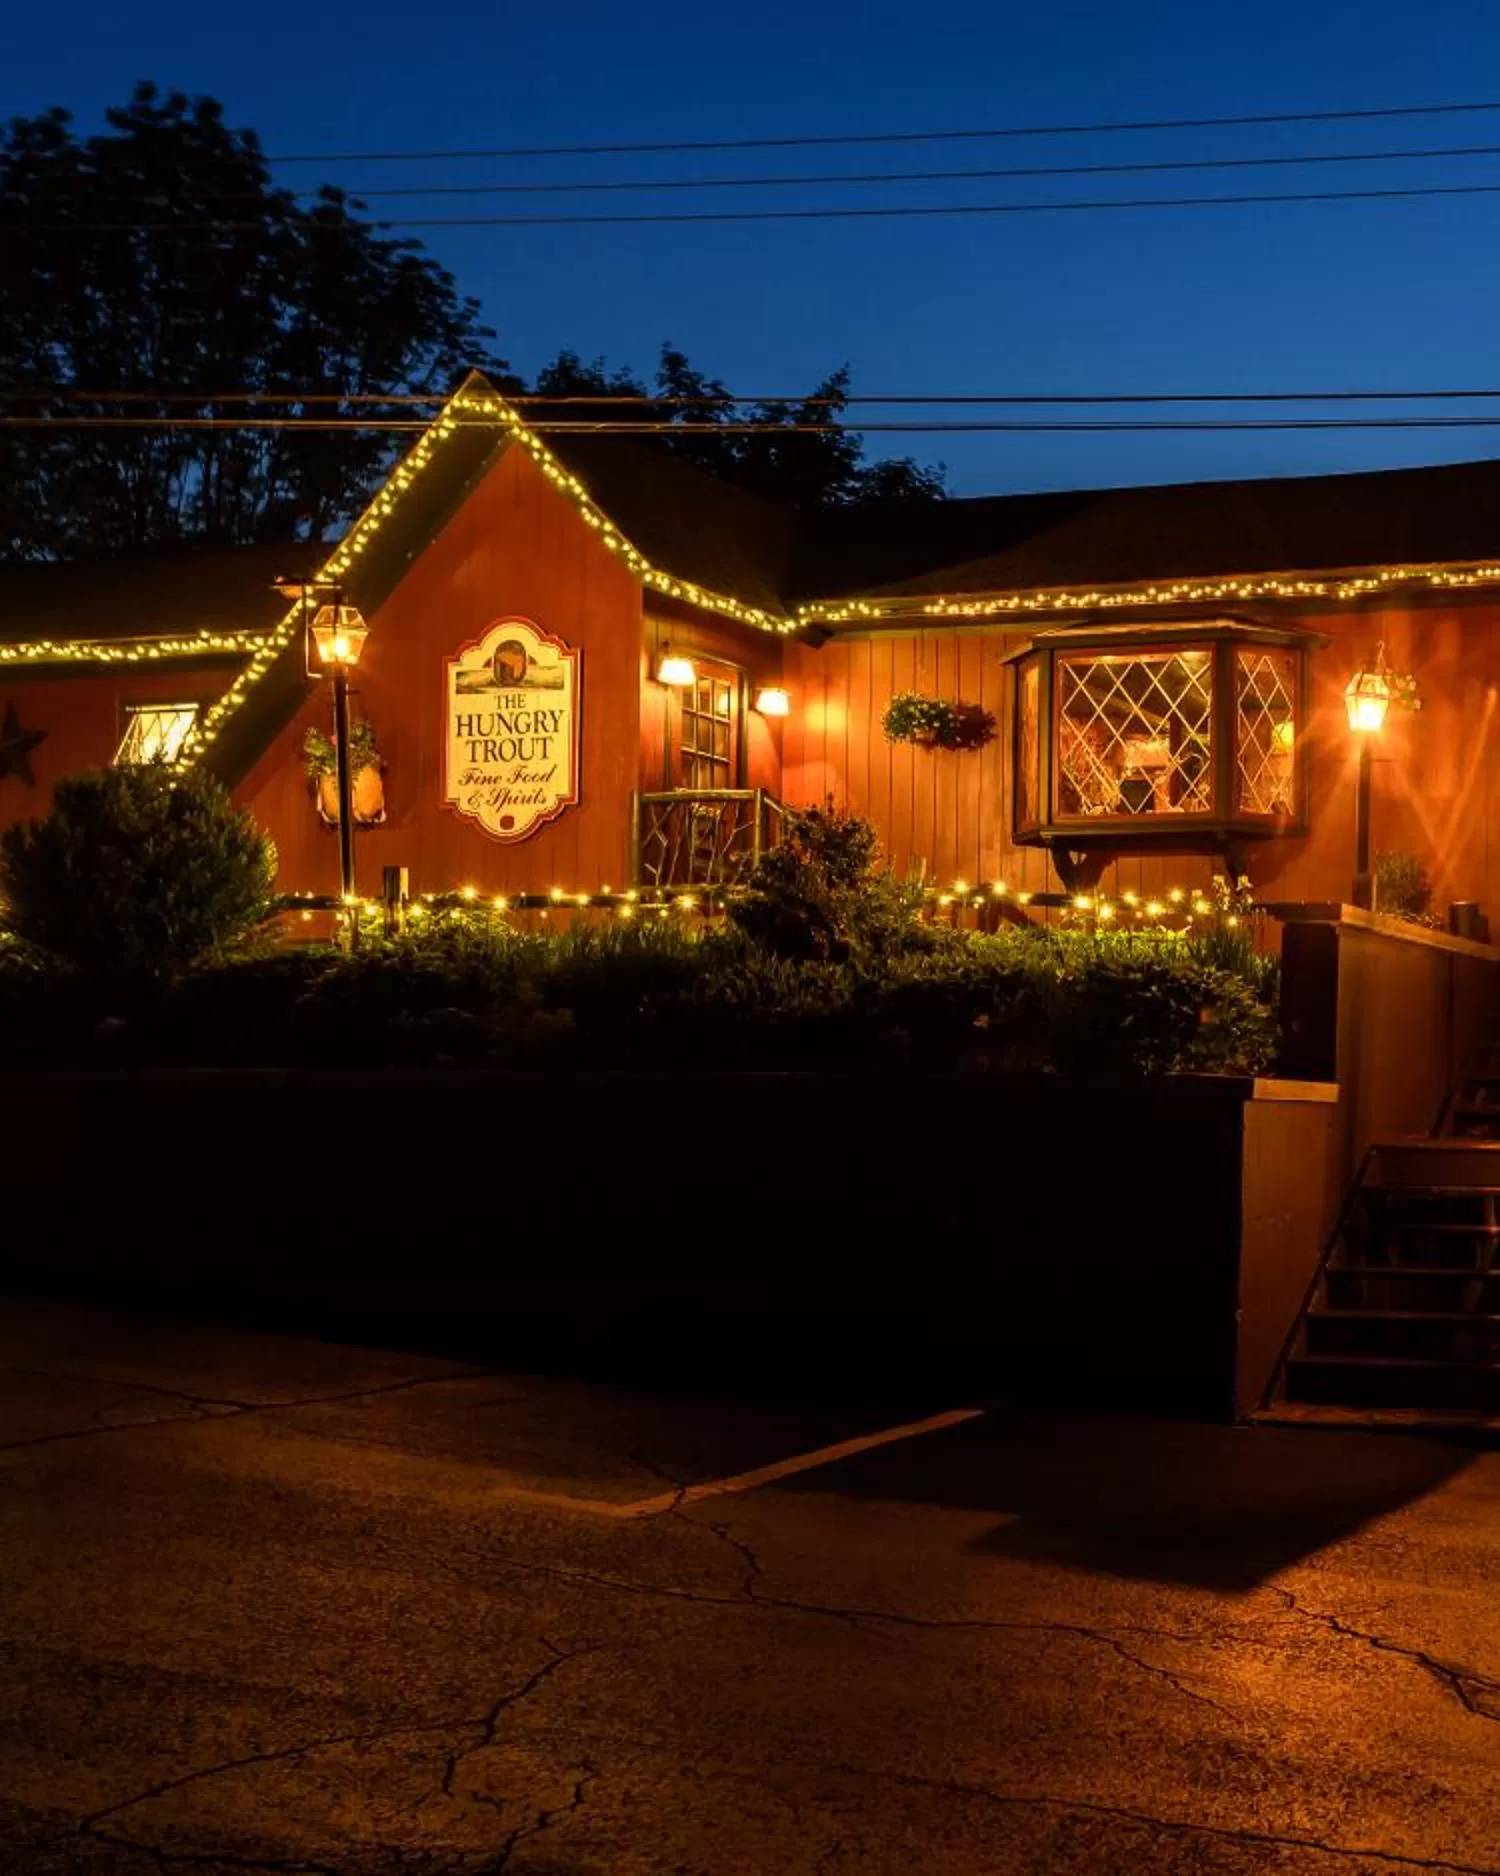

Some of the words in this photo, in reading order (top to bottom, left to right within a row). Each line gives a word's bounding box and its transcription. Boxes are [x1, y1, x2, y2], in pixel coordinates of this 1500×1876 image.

[494, 694, 527, 709] THE
[455, 709, 565, 737] HUNGRY
[465, 736, 554, 763] TROUT
[458, 766, 503, 786] Fine
[507, 763, 558, 785] Food
[467, 788, 485, 811] &
[485, 787, 547, 813] Spirits
